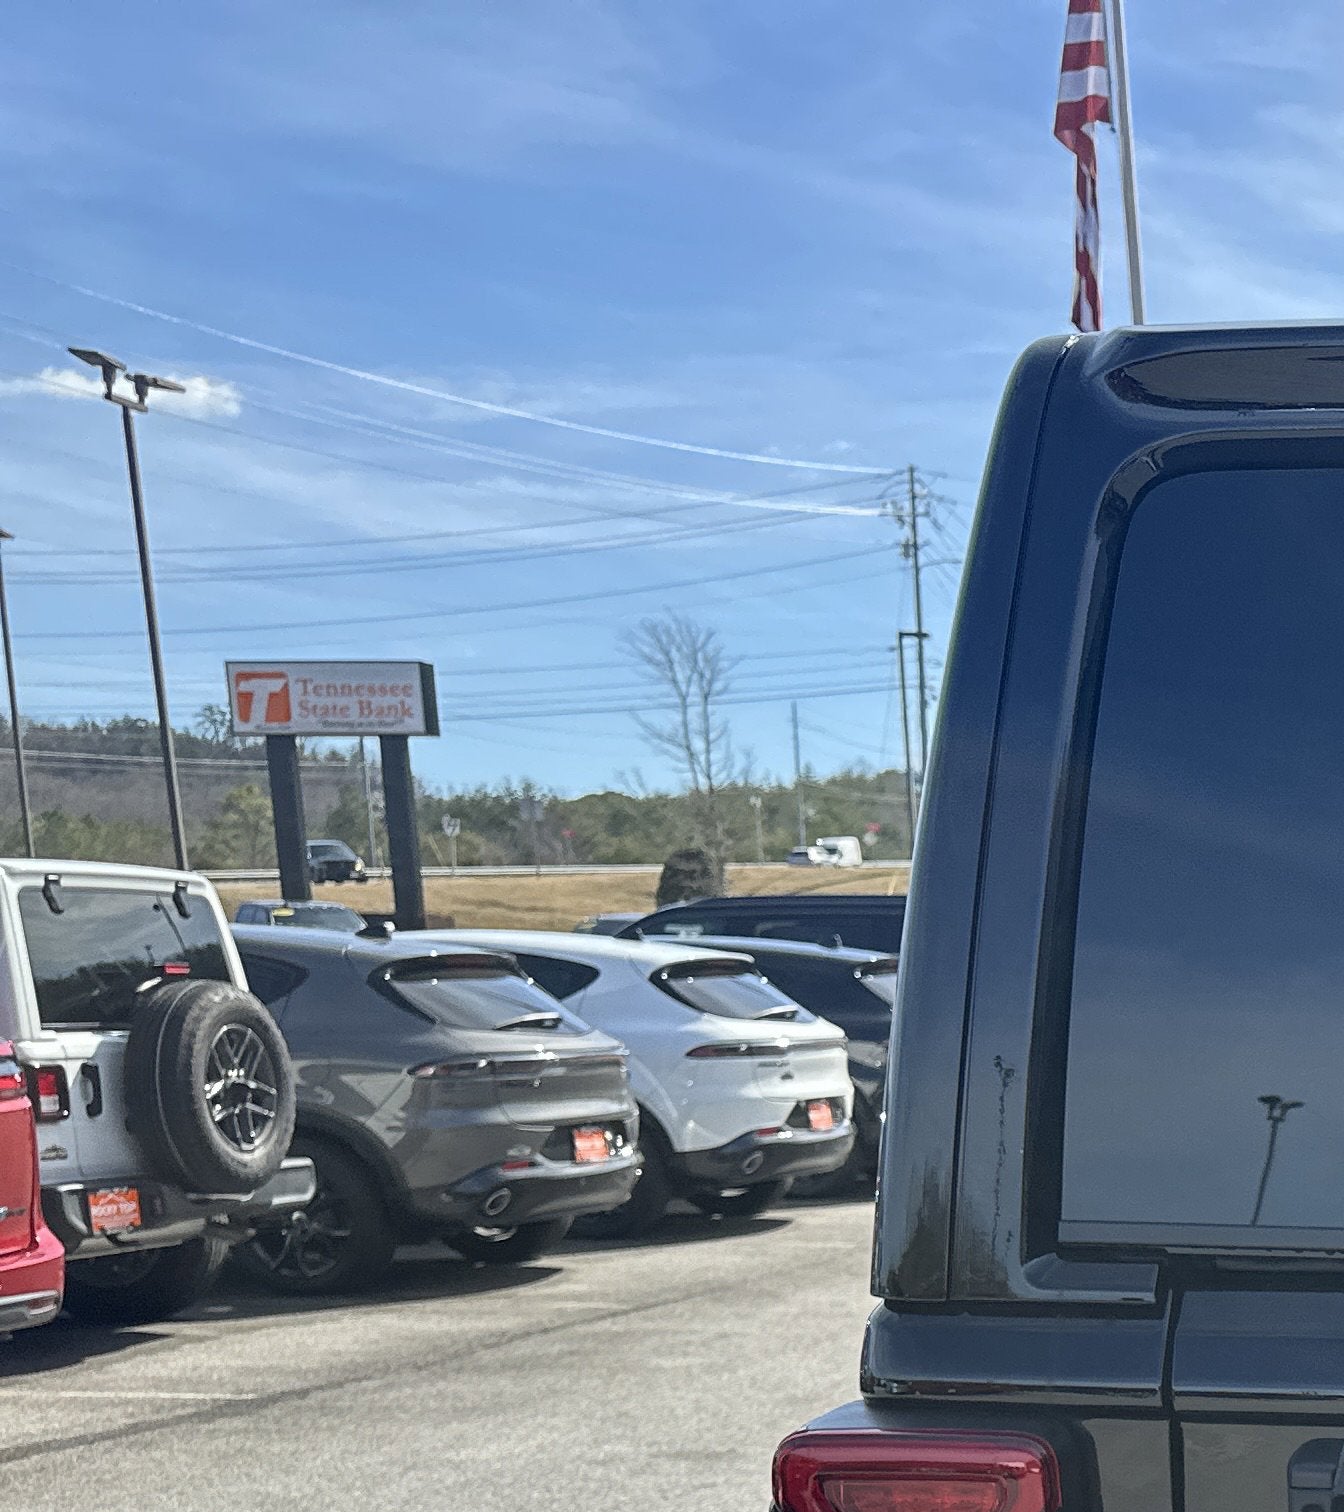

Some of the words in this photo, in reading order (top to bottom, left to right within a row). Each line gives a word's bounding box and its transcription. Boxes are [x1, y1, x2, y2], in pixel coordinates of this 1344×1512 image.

[295, 678, 414, 698] Tennessee
[298, 700, 351, 719] State
[358, 699, 414, 719] Bank
